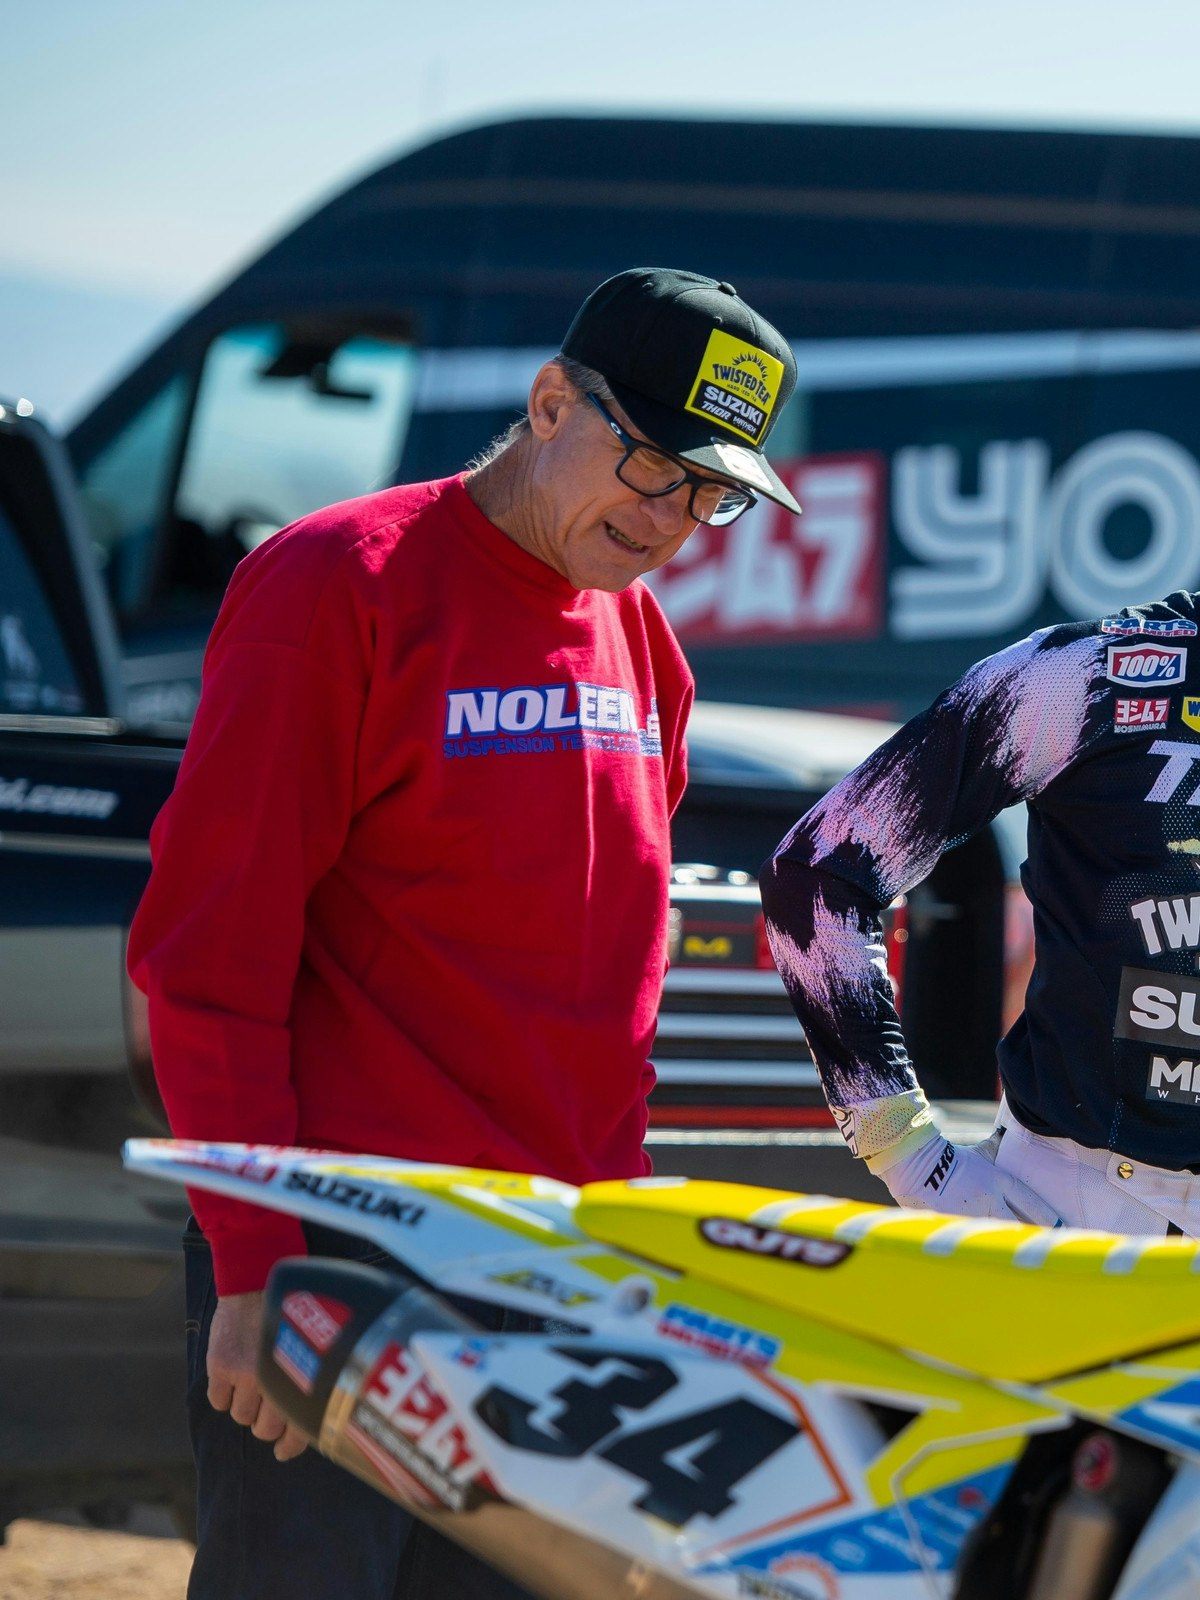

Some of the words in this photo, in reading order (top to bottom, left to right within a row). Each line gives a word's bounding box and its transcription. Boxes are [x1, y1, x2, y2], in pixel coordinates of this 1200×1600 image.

[712, 363, 757, 391] TWISTED
[756, 379, 771, 405] TEA
[701, 401, 731, 421] THOR
[704, 385, 764, 426] SUZUKI
[1102, 618, 1196, 631] PARTS
[1117, 654, 1177, 678] 100%
[1116, 699, 1168, 723] ヨシムラ
[443, 737, 555, 758] SUSPENSION
[285, 1169, 427, 1228] SUZUKI
[474, 1344, 804, 1529] 34
